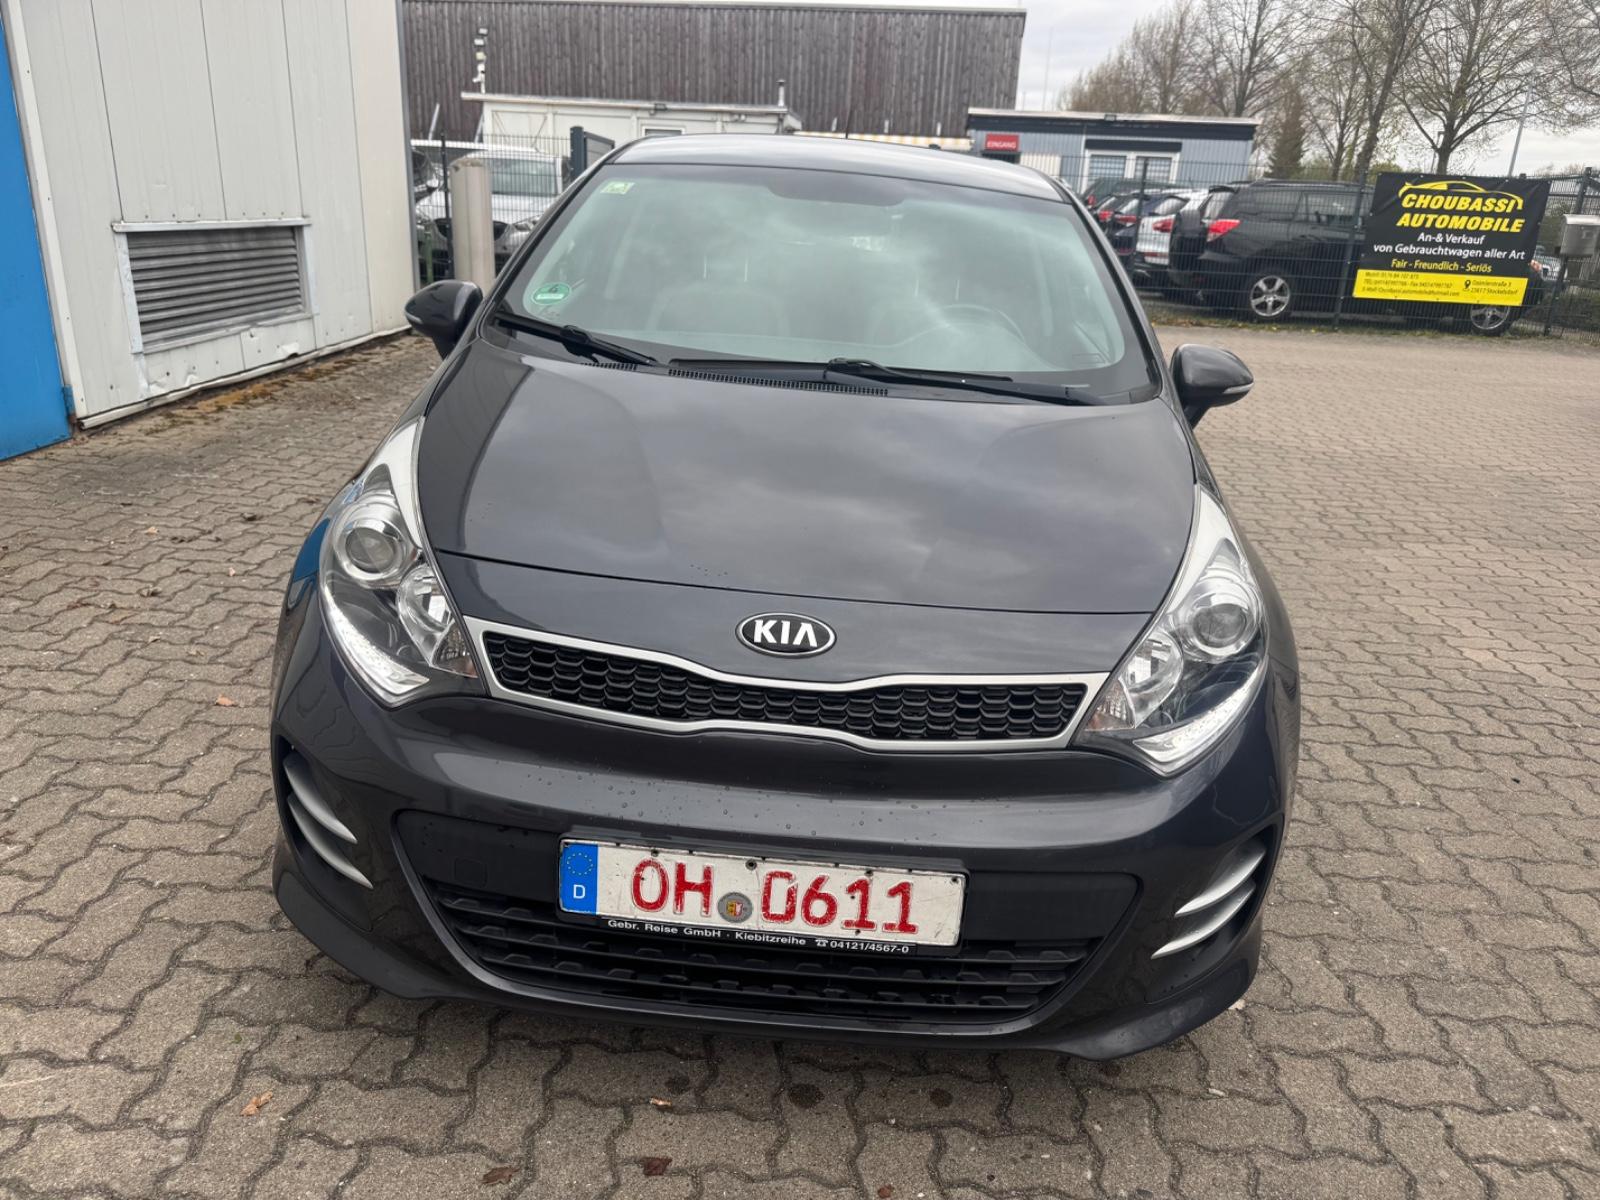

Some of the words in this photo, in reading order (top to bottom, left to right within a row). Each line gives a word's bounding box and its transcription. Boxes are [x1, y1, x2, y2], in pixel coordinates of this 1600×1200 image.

[1401, 193, 1516, 213] CHOUBASSI
[1396, 213, 1525, 233] AUTOMOBILE
[1445, 234, 1486, 245] Verkauf
[1373, 244, 1393, 253] von
[1395, 243, 1483, 259] Gebrauchtwagen
[1484, 248, 1507, 260] aller
[1508, 249, 1526, 260] Art
[1390, 258, 1407, 268] Fair
[1414, 260, 1459, 271] Freundlich
[1465, 263, 1492, 273] Seriös
[753, 619, 818, 648] KIA
[573, 884, 586, 899] D
[631, 857, 714, 917] OH
[761, 870, 920, 934] 0611
[607, 919, 640, 930] Gebr.
[644, 923, 679, 934] Reise
[683, 926, 721, 938] GmbH
[735, 931, 807, 946] Kiebitzreihe
[830, 940, 909, 954] 04121/4567-0
